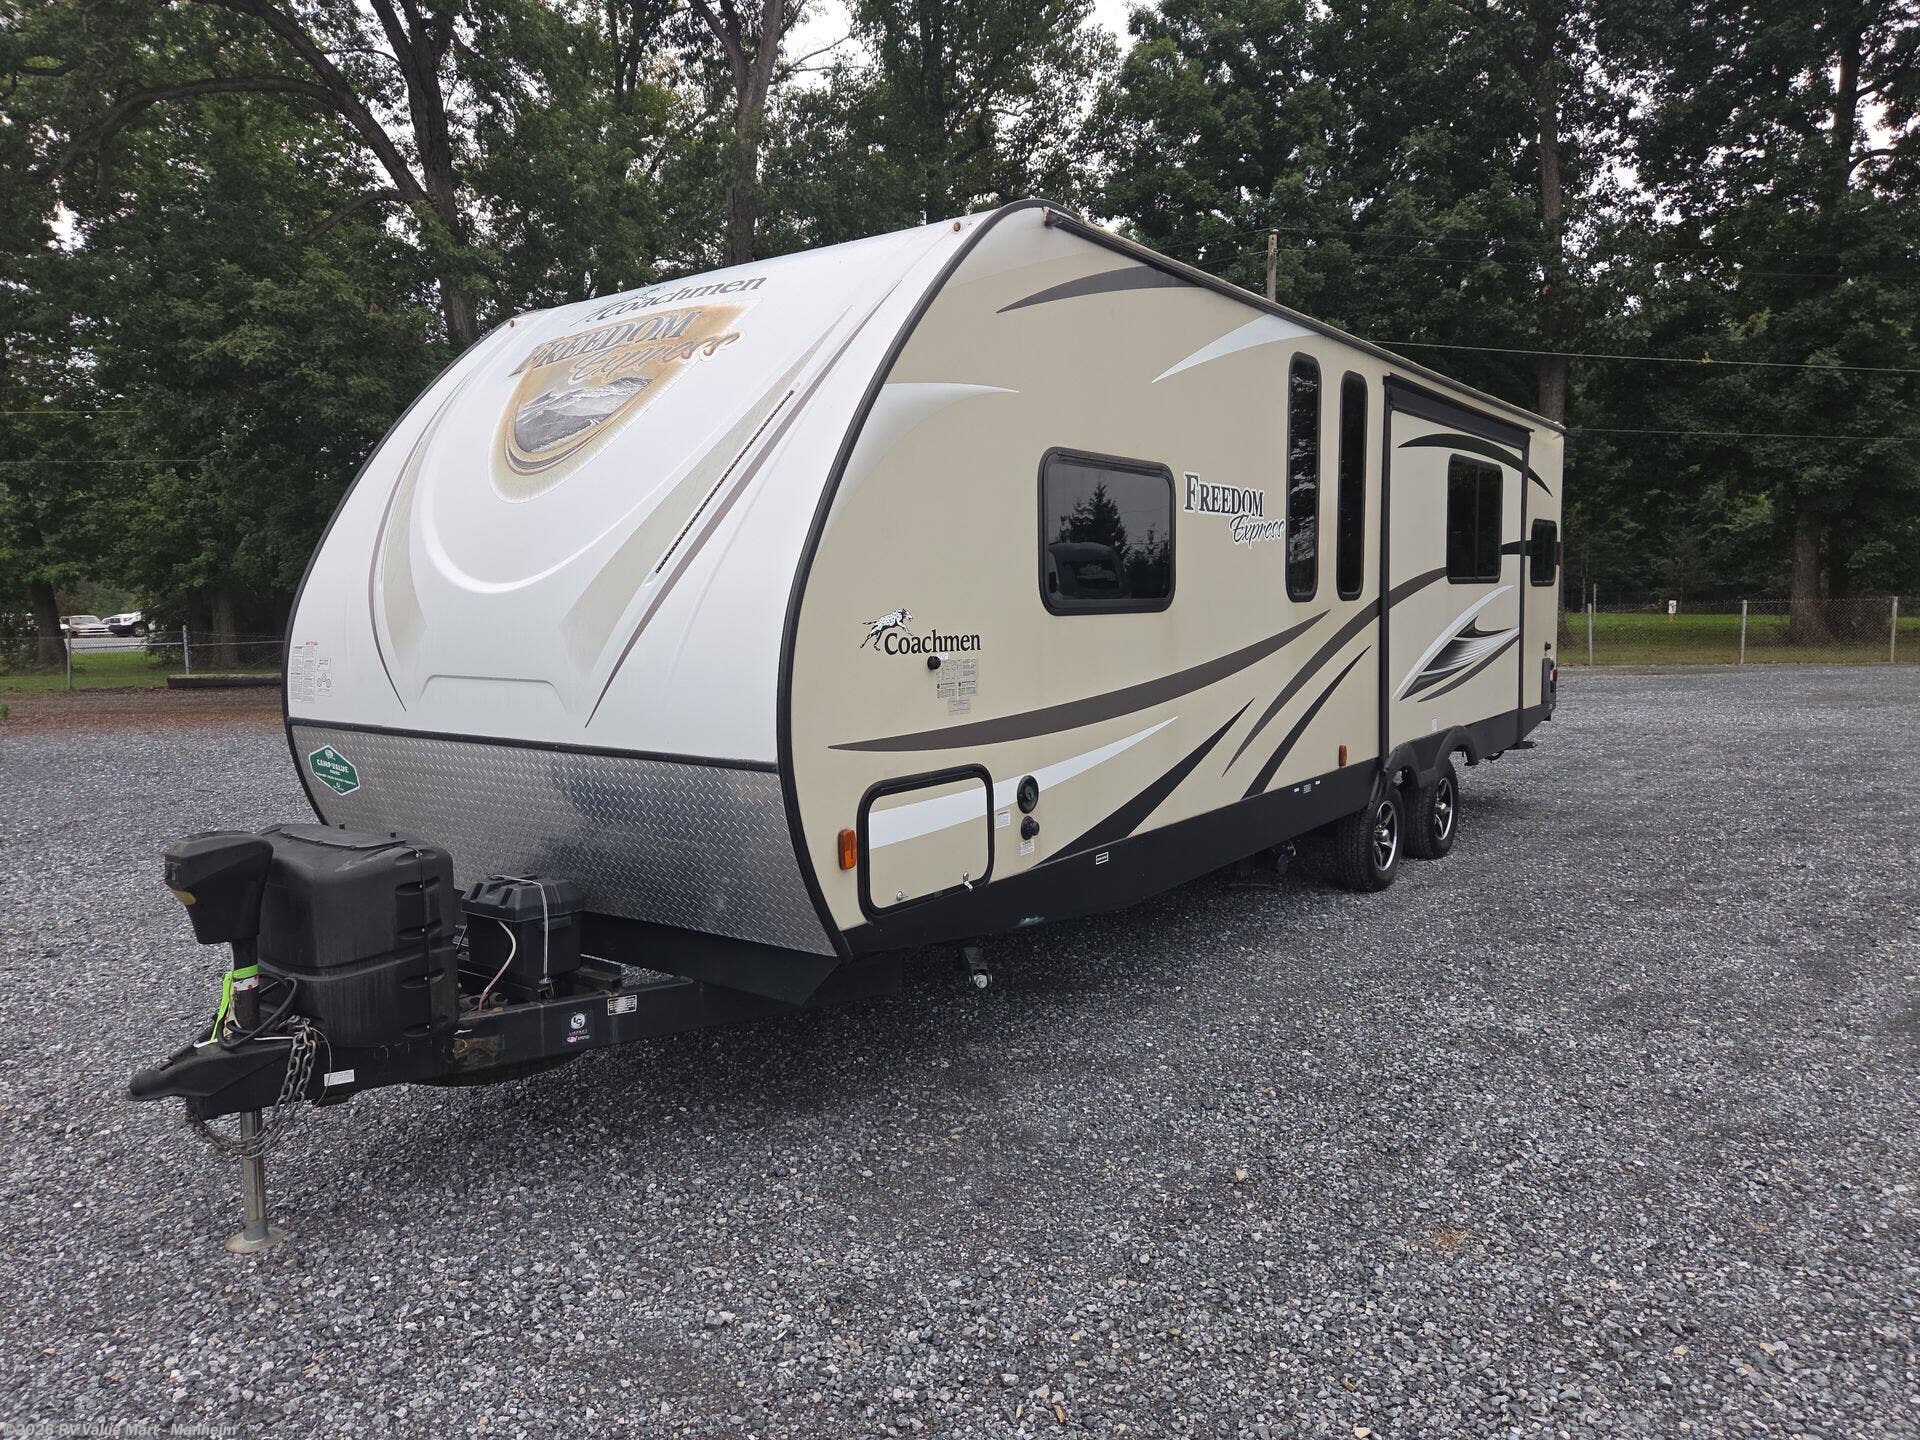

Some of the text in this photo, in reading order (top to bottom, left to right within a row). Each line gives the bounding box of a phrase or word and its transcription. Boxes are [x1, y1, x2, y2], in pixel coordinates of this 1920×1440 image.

[596, 277, 768, 321] Coachmen
[508, 311, 702, 378] FREEDOM
[1184, 473, 1264, 518] FREEDOM
[1229, 514, 1286, 547] Express
[884, 629, 981, 655] Coachmen
